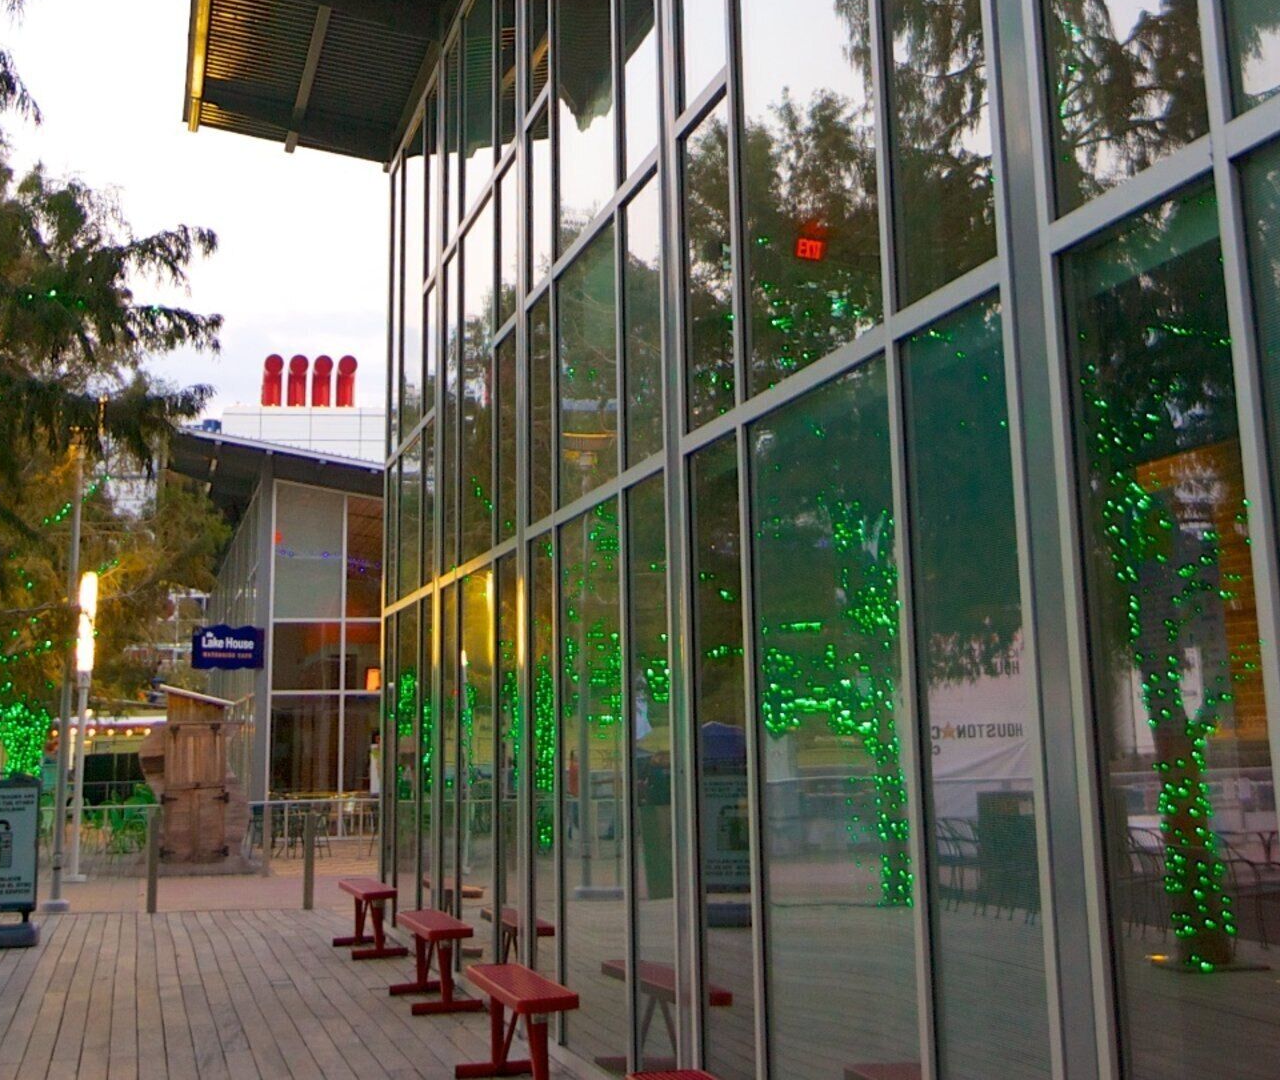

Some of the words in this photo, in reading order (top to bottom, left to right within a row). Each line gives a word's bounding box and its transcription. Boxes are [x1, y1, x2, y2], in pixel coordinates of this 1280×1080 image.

[797, 237, 823, 260] EXIT
[202, 636, 224, 649] Lake
[225, 637, 255, 650] House
